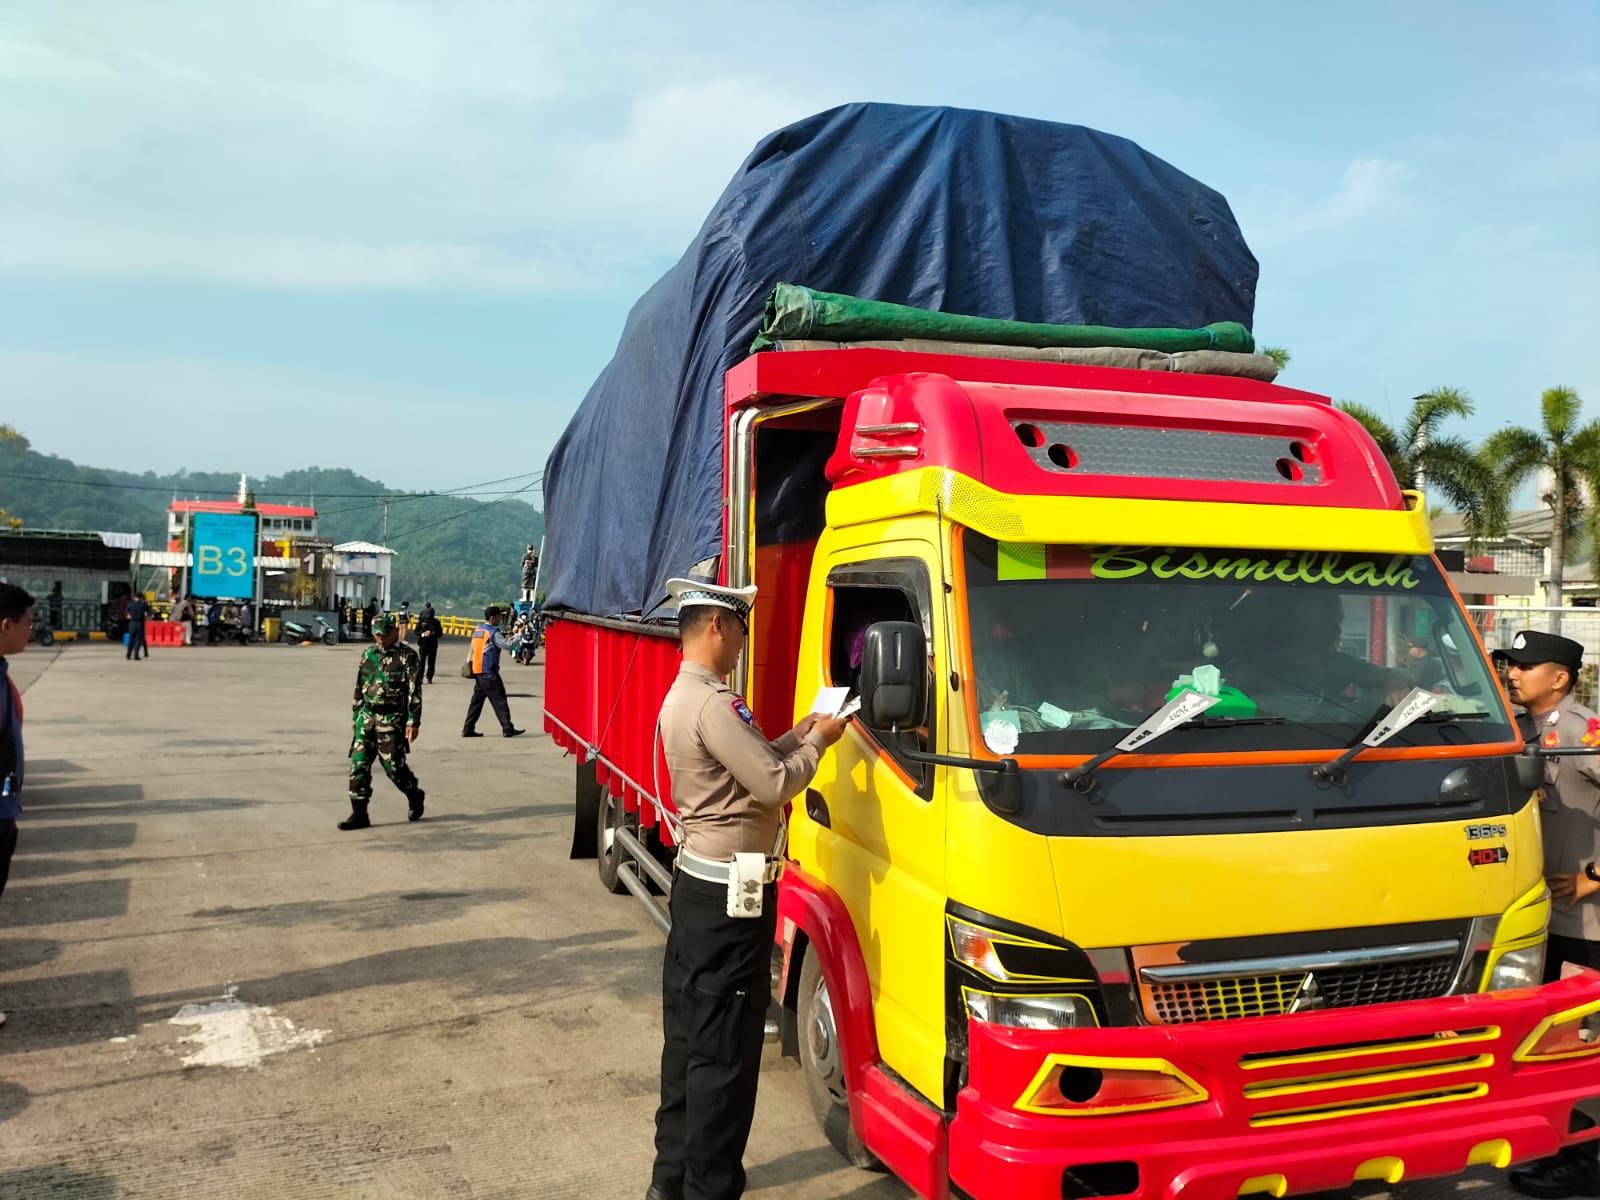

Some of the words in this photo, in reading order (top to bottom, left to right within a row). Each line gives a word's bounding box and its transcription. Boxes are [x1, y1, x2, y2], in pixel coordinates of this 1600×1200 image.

[198, 545, 248, 577] B3
[1090, 546, 1420, 589] Bismillah
[1464, 823, 1507, 840] 136PS
[1470, 848, 1507, 865] HD-L
